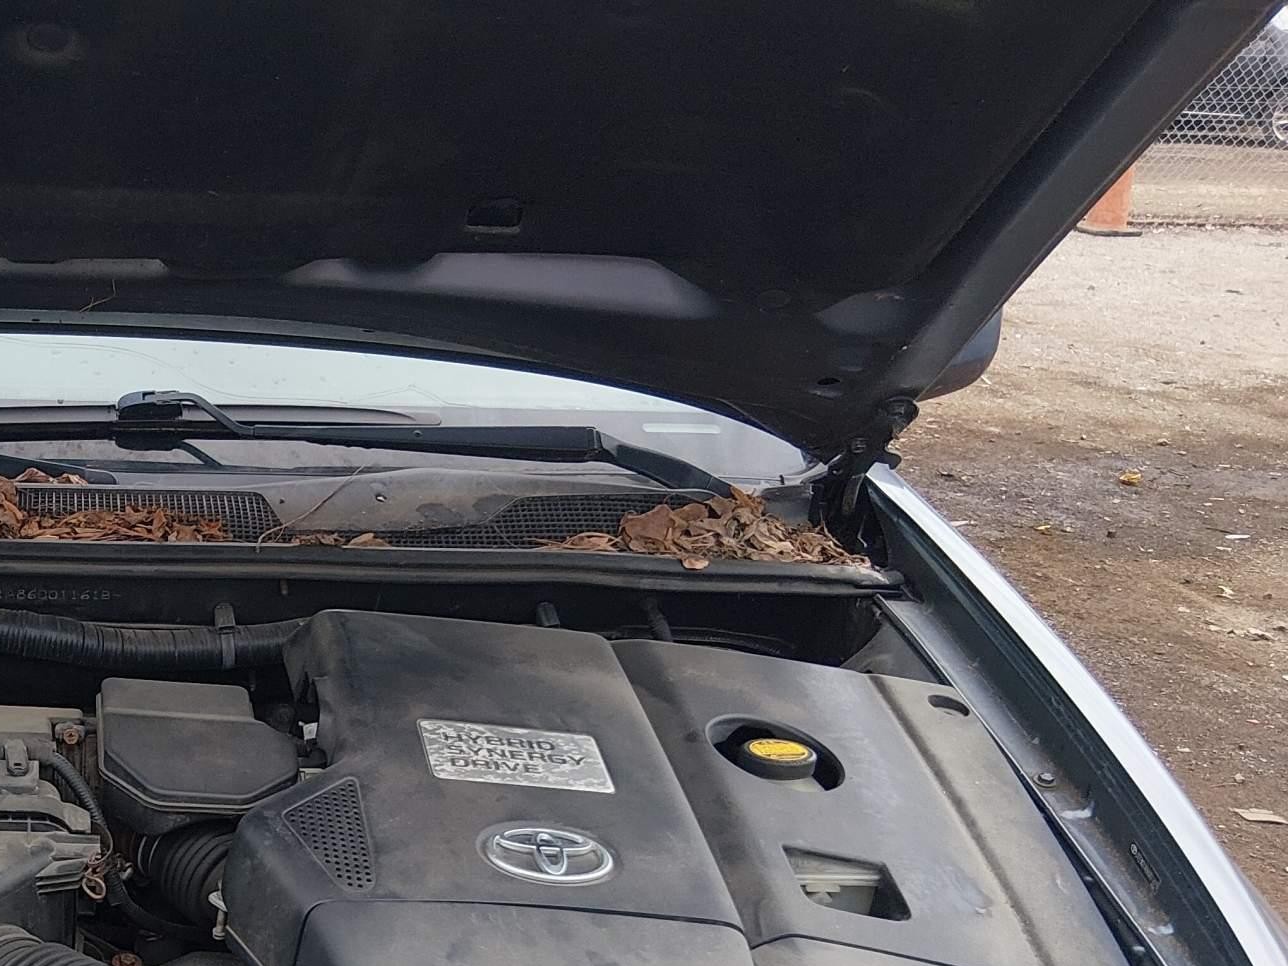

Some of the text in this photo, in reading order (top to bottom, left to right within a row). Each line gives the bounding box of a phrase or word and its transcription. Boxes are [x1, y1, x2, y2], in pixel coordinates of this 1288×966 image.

[443, 732, 556, 751] HYBRID
[447, 744, 585, 766] SYNERGY
[450, 757, 542, 774] DRIVE
